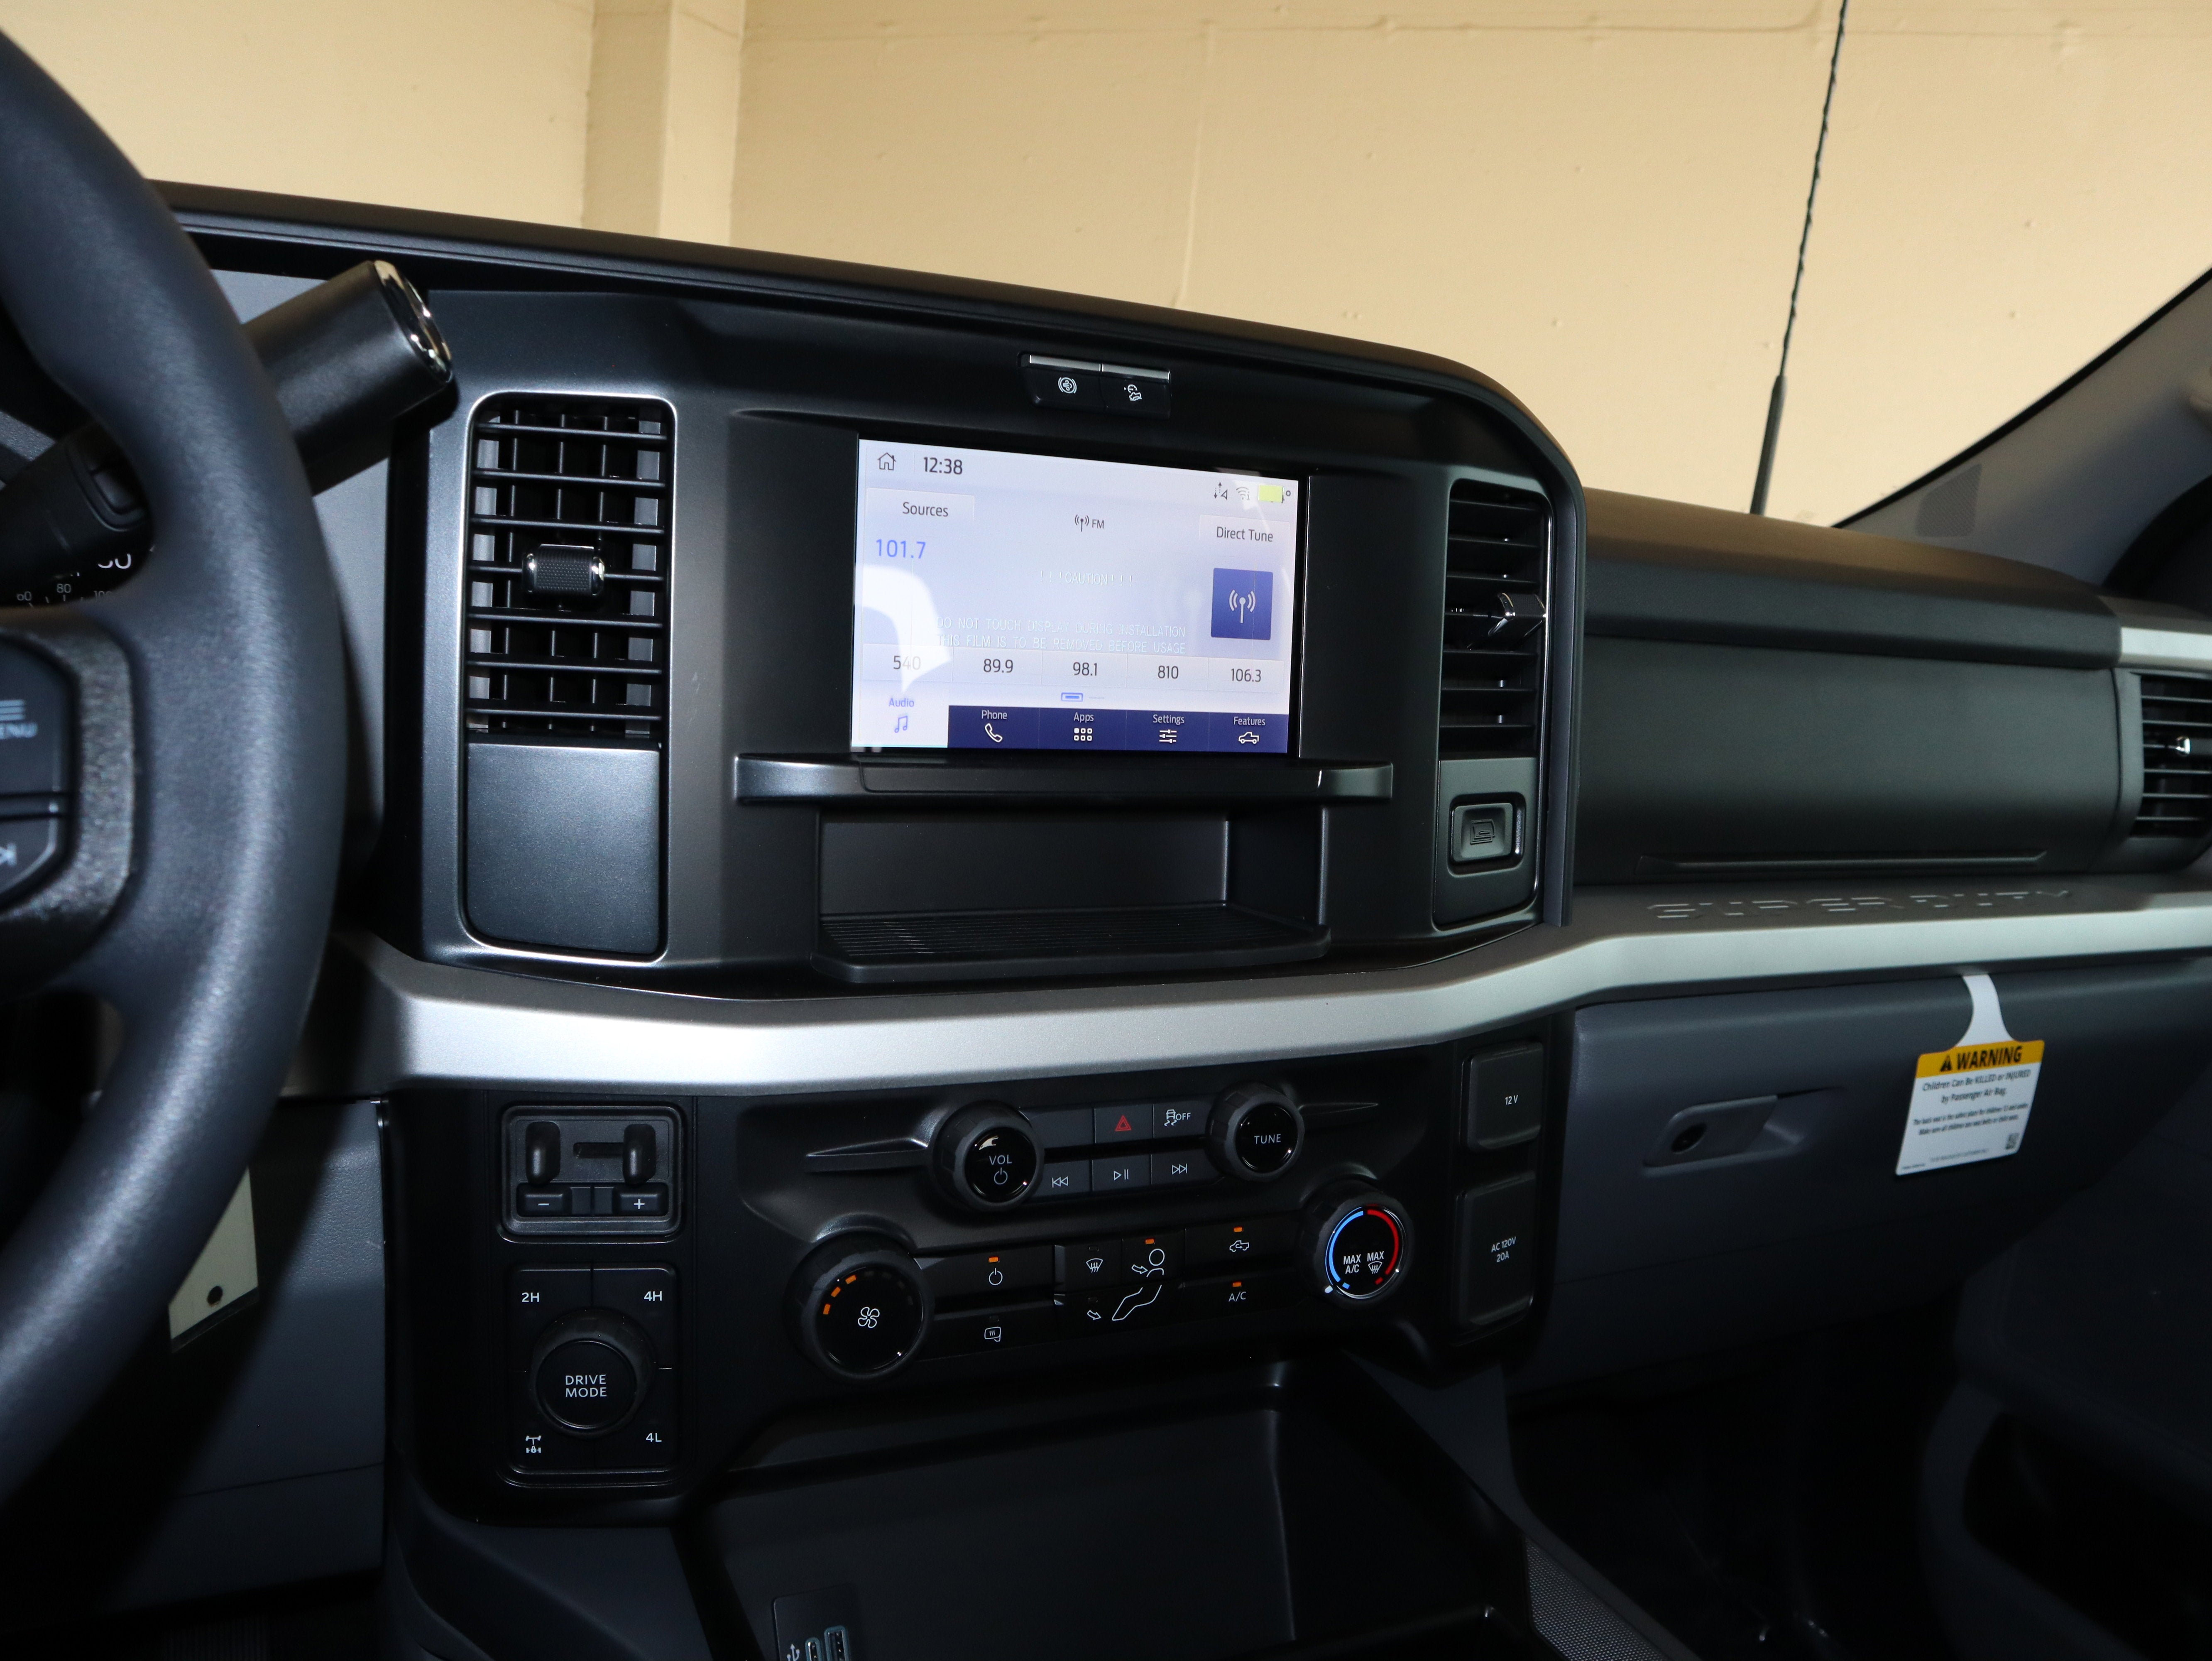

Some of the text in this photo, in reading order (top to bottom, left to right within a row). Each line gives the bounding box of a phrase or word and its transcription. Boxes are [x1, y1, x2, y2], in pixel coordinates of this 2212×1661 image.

[923, 456, 963, 475] 12:38
[902, 501, 949, 517] Sources
[1092, 519, 1104, 529] FM
[1216, 526, 1273, 542] Direct Tune
[876, 538, 926, 559] 101.7
[56, 583, 71, 593] 80
[937, 616, 952, 630] DO
[958, 617, 979, 630] NOT
[986, 618, 1021, 632] TOUCH
[1075, 622, 1113, 635] DURING
[1118, 624, 1186, 637] INSTALLATION
[938, 634, 1186, 654] THIS FILM IS TO BE REMOVED BEFORE USAGE
[893, 655, 921, 671] 540
[983, 659, 1013, 674] 89.9
[1072, 662, 1098, 676] 98.1
[1157, 665, 1179, 679] 810
[1231, 668, 1262, 682] 106.3
[888, 698, 915, 708] Audio
[981, 710, 1008, 720] Phone
[1073, 712, 1094, 723] Apps
[1152, 714, 1185, 725] Settings
[1233, 716, 1266, 727] Features
[1957, 1046, 2023, 1071] WARNING
[1922, 1068, 2031, 1091] Children Can Be KILLED or INJURED
[1505, 1095, 1519, 1106] 12 V
[1941, 1094, 1950, 1105] by
[1951, 1089, 1982, 1102] Passenger
[1984, 1087, 1993, 1096] Air
[1175, 1111, 1192, 1122] OFF
[1253, 1133, 1282, 1144] TUNE
[989, 1154, 1013, 1165] VOL
[1490, 1236, 1517, 1253] AC 120V
[1343, 1254, 1361, 1265] MAX
[1366, 1250, 1385, 1262] MAX
[1496, 1252, 1510, 1263] 20A
[1345, 1264, 1360, 1275] A/C
[521, 1292, 540, 1303] 2H
[644, 1290, 663, 1302] 4H
[1228, 1291, 1246, 1302] A/C
[565, 1374, 607, 1385] DRIVE
[565, 1387, 607, 1398] MODE
[646, 1432, 662, 1443] 4L
